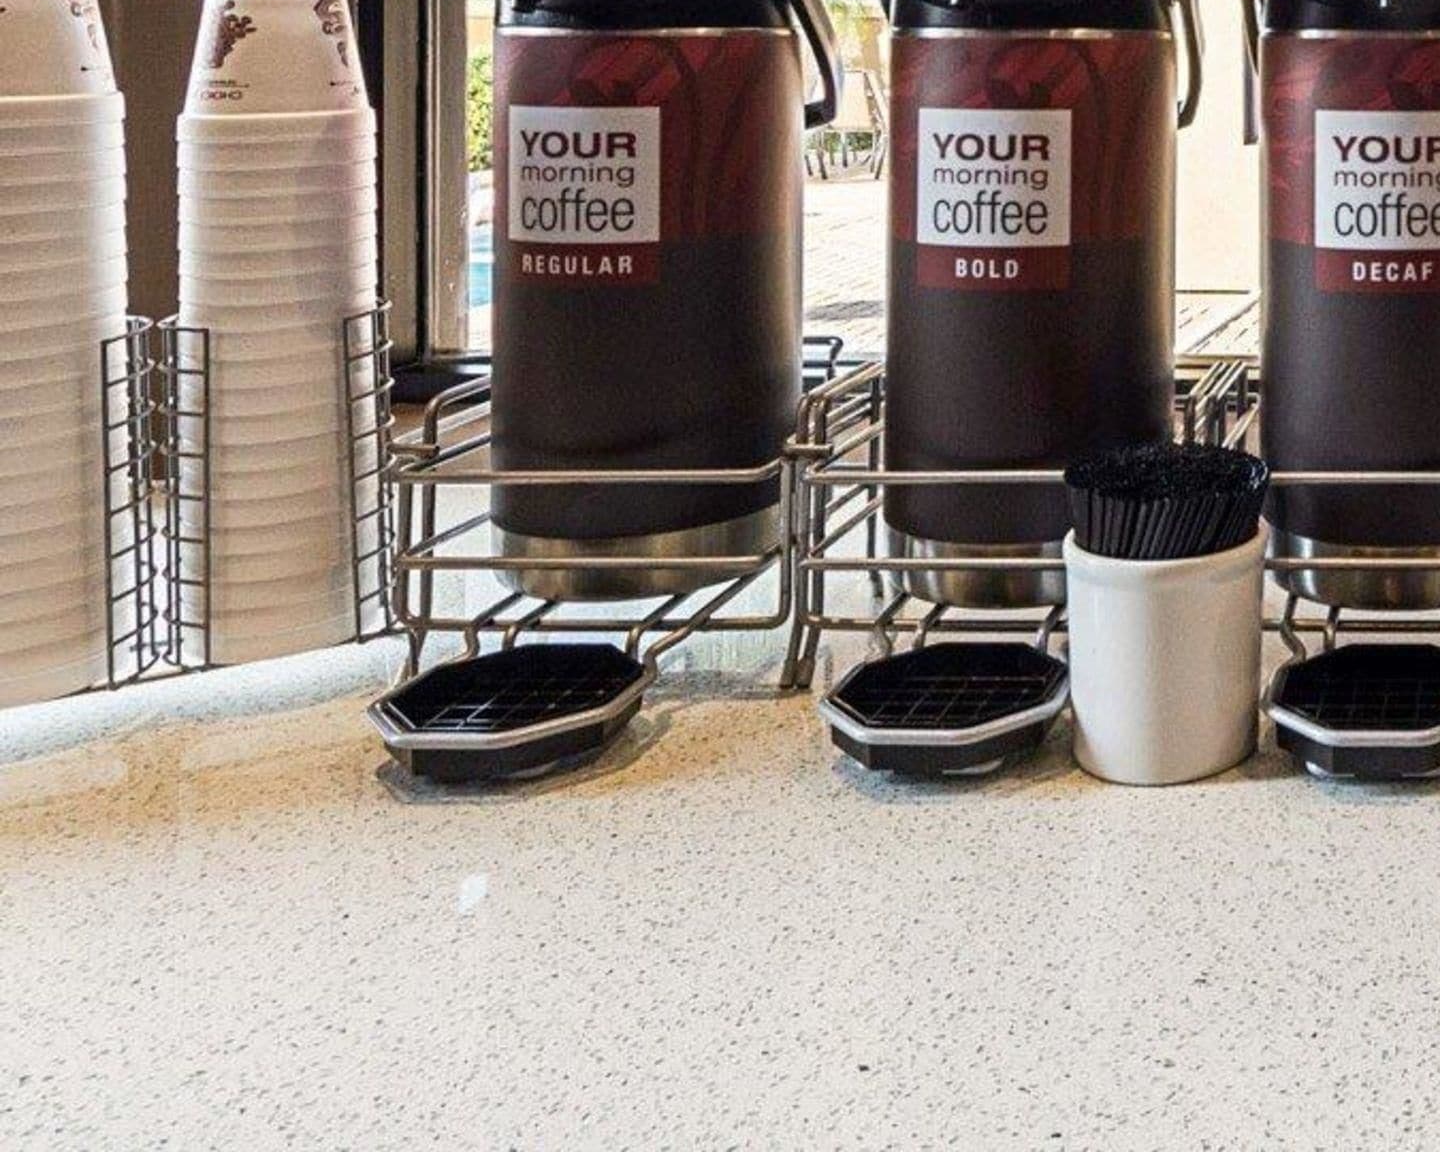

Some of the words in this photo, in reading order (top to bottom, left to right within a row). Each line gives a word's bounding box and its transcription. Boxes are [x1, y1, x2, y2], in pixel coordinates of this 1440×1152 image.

[520, 130, 637, 160] YOUR
[932, 133, 1051, 162] YOUR
[520, 163, 636, 187] morning
[932, 164, 1049, 190] morning
[520, 188, 636, 233] coffee
[932, 190, 1048, 235] coffee
[521, 253, 633, 276] REGULAR
[954, 258, 1020, 279] BOLD
[1352, 260, 1433, 282] DECAF
